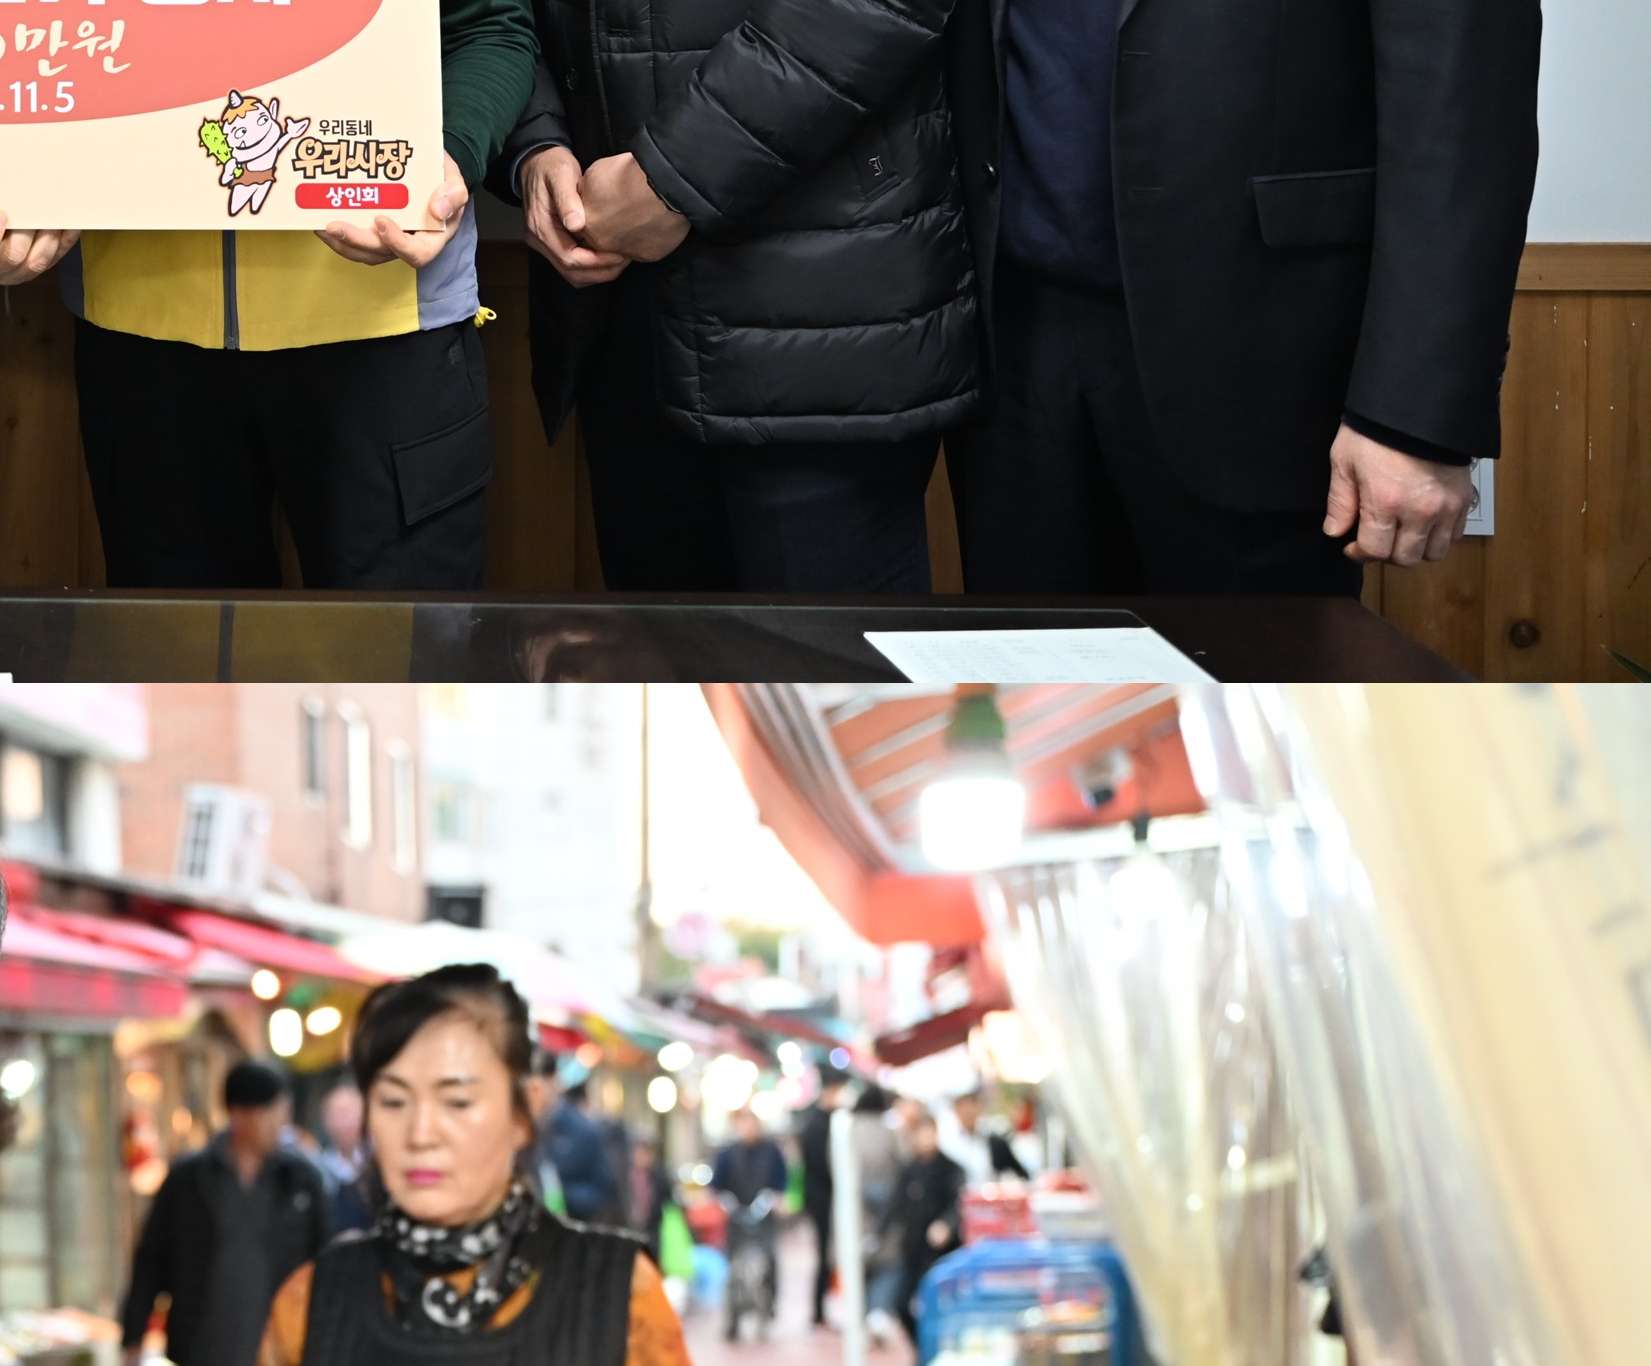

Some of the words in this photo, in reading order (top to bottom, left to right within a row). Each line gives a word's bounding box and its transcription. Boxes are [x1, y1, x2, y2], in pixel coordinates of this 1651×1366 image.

[318, 119, 373, 136] 우리동네
[292, 137, 413, 181] 우리시장
[325, 186, 380, 207] 상인회
